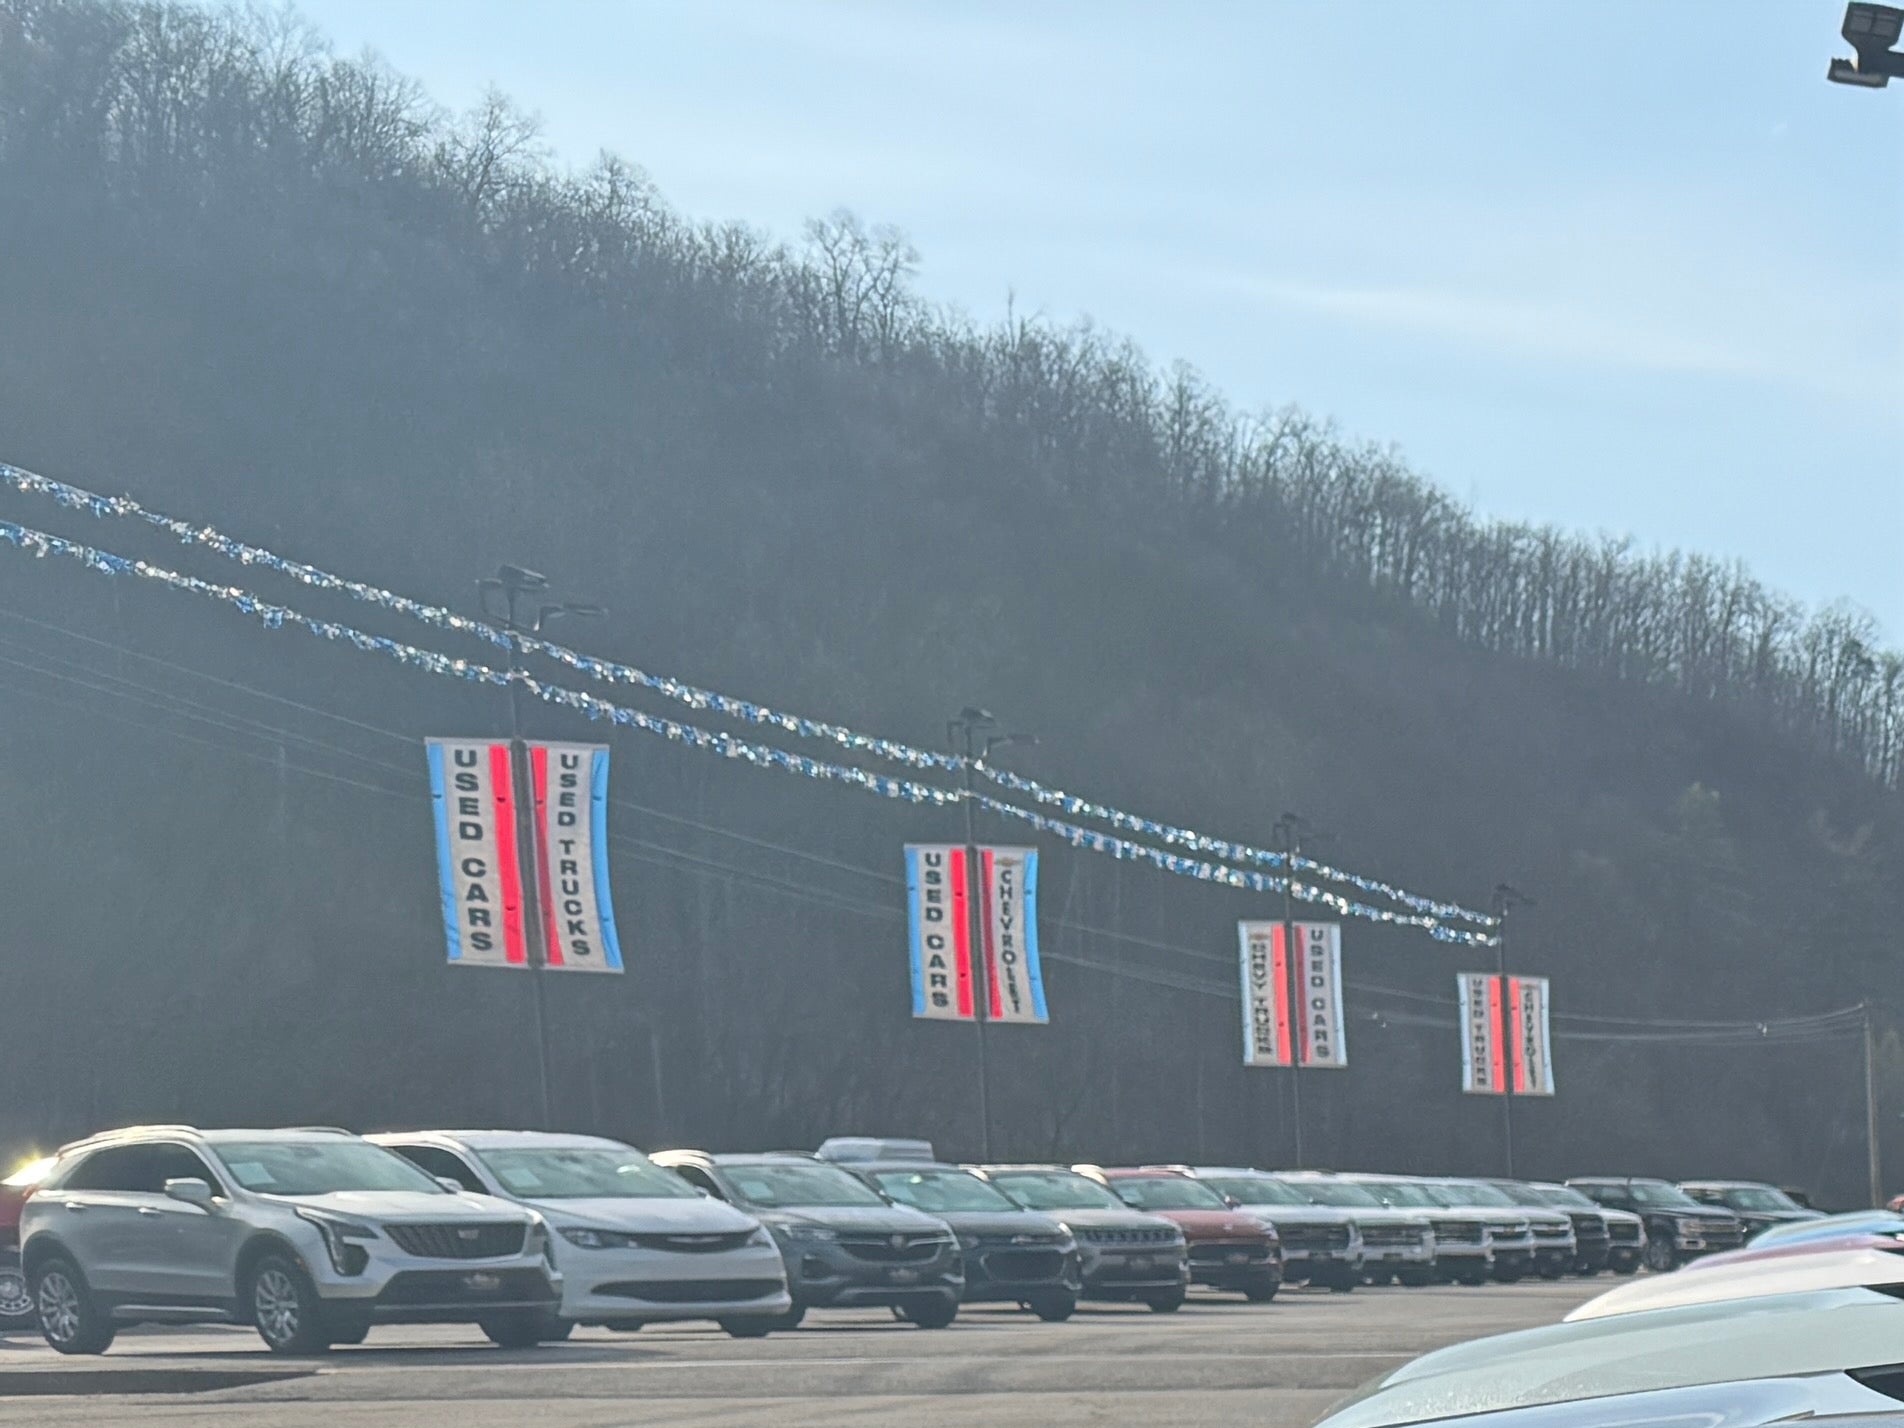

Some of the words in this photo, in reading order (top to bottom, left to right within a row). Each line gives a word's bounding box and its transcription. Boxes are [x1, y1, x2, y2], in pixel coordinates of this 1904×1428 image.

[454, 749, 483, 840] USED
[558, 754, 579, 827] USED
[461, 858, 493, 951] CARS
[559, 840, 590, 955] TRUCKS
[925, 852, 943, 922] USED
[927, 934, 948, 1008] CARS
[1000, 870, 1020, 1013] CHEVROLET
[1311, 929, 1324, 988] USED
[1312, 997, 1330, 1057] CARS
